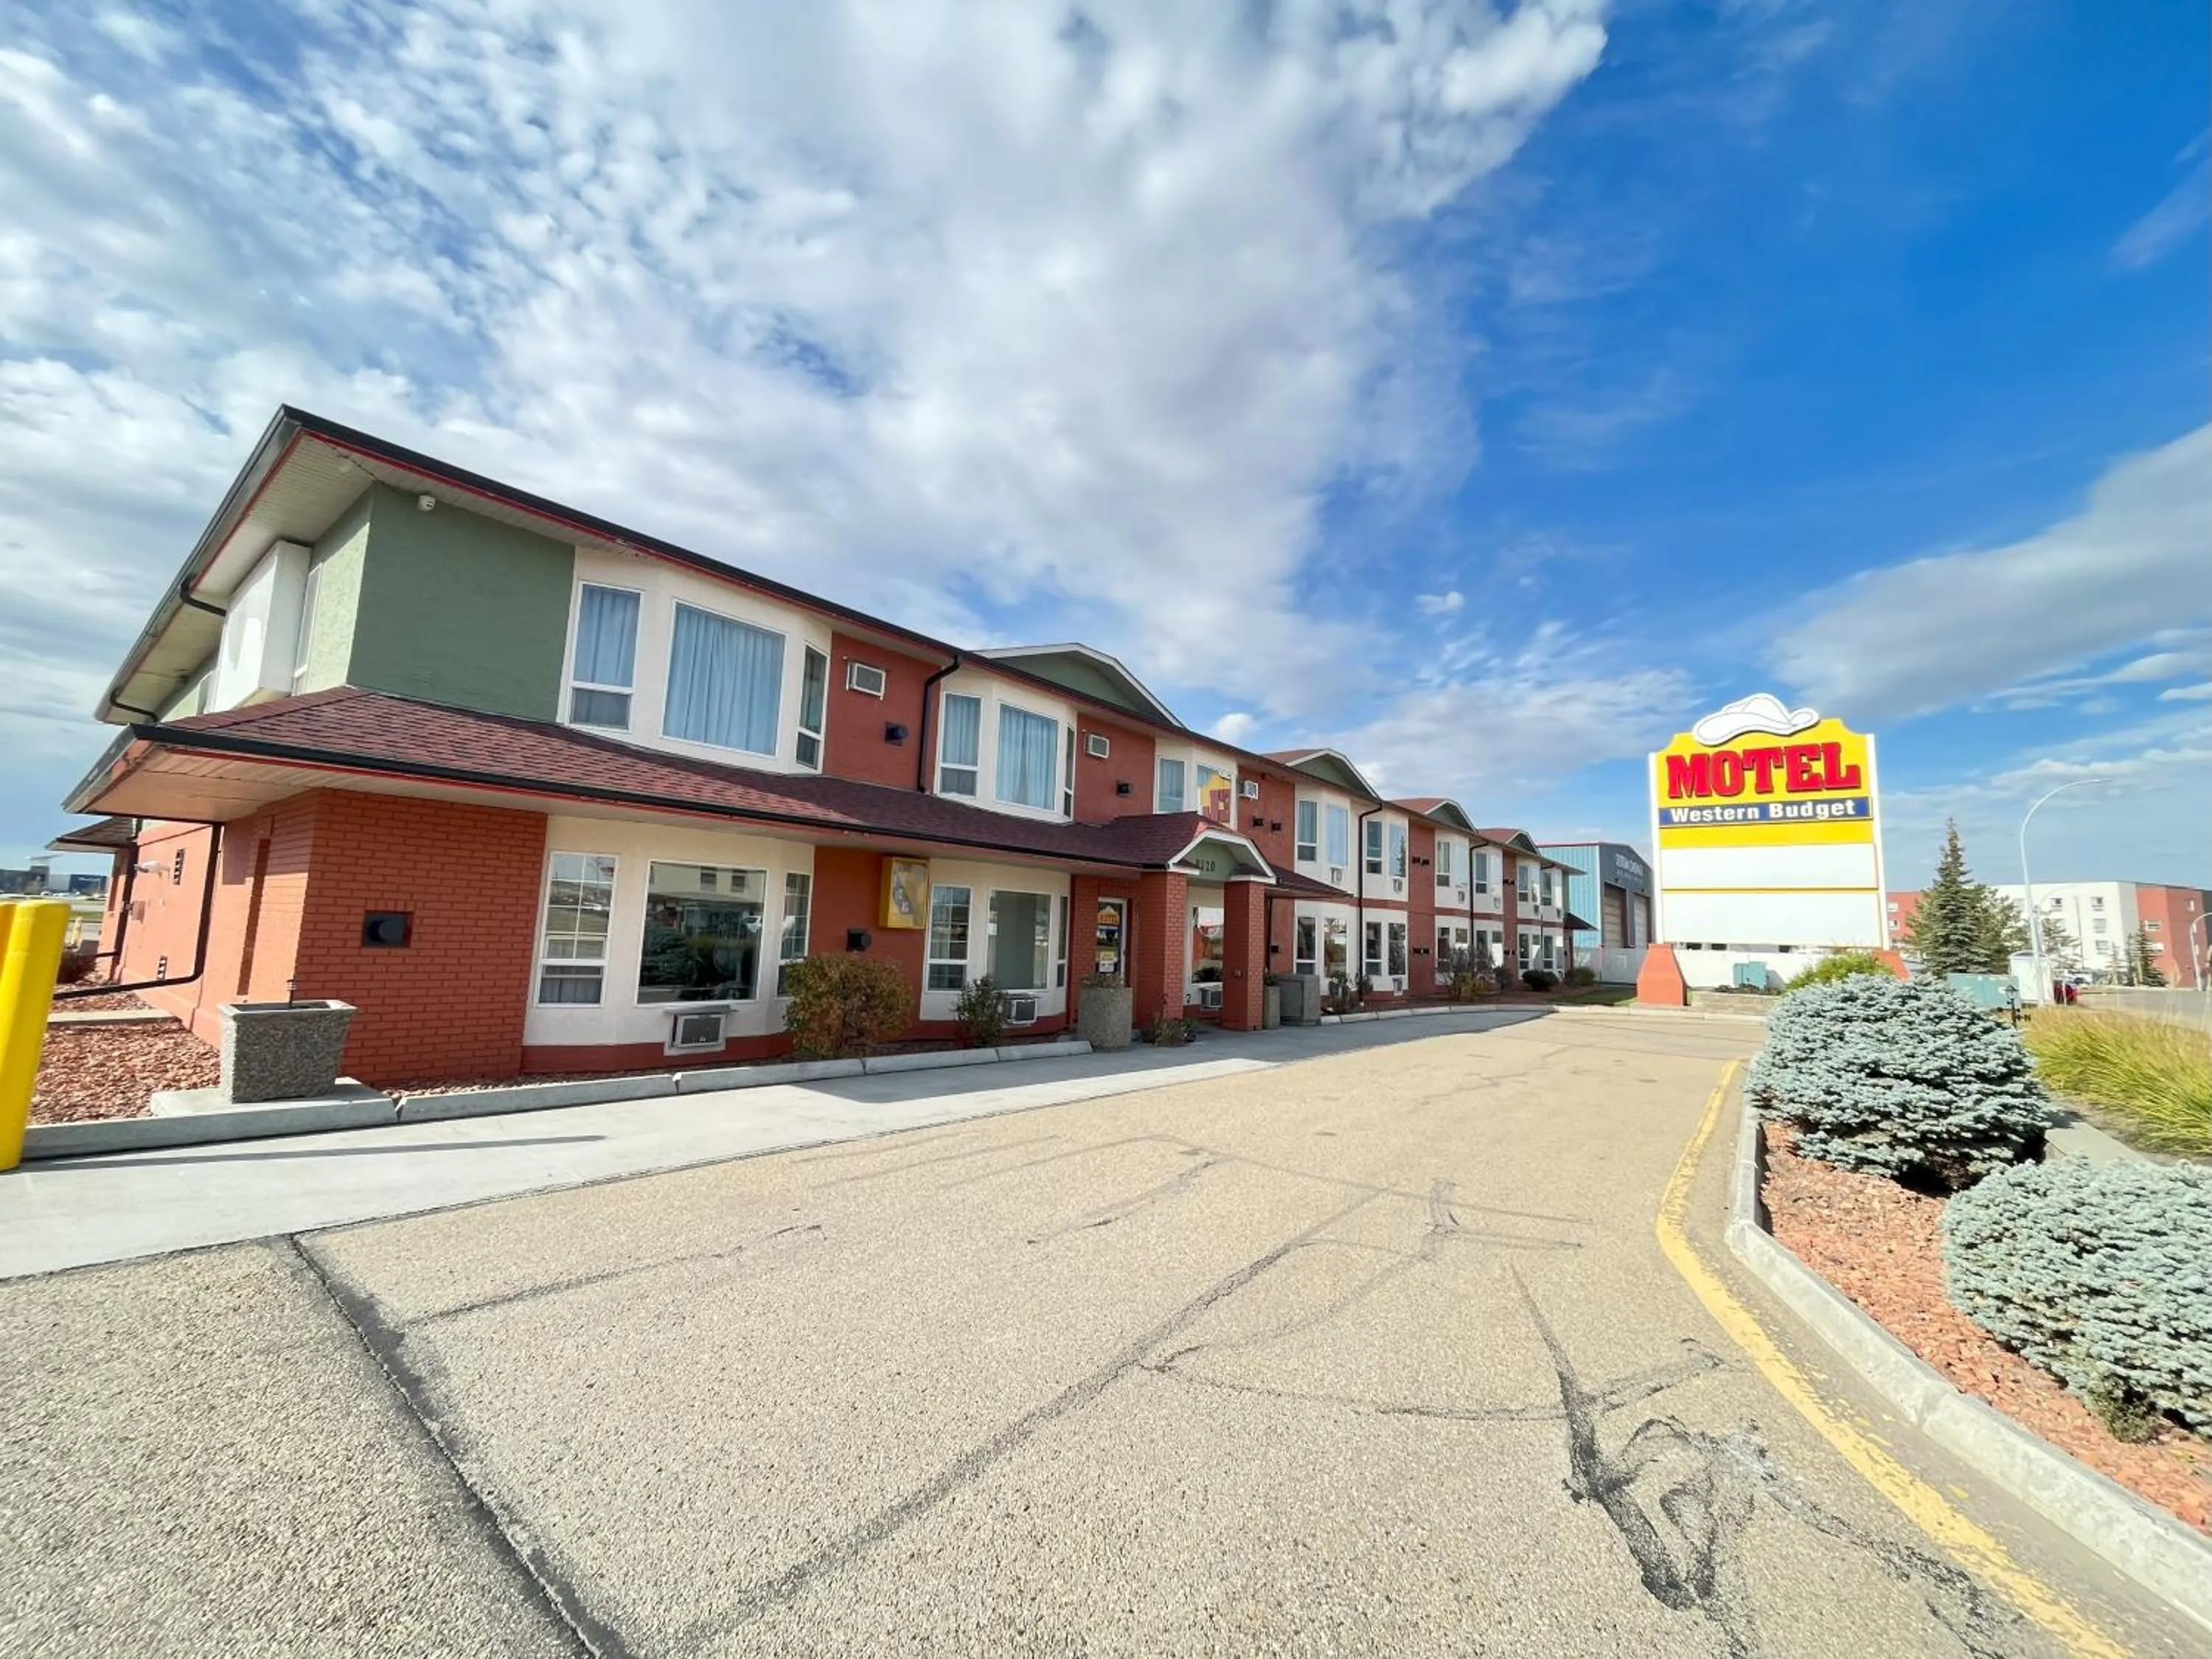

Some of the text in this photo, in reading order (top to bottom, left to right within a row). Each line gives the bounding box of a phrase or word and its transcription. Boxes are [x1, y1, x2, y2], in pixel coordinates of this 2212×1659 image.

[1666, 742, 1862, 799] MOTEL
[1670, 799, 1856, 823] Western Budget
